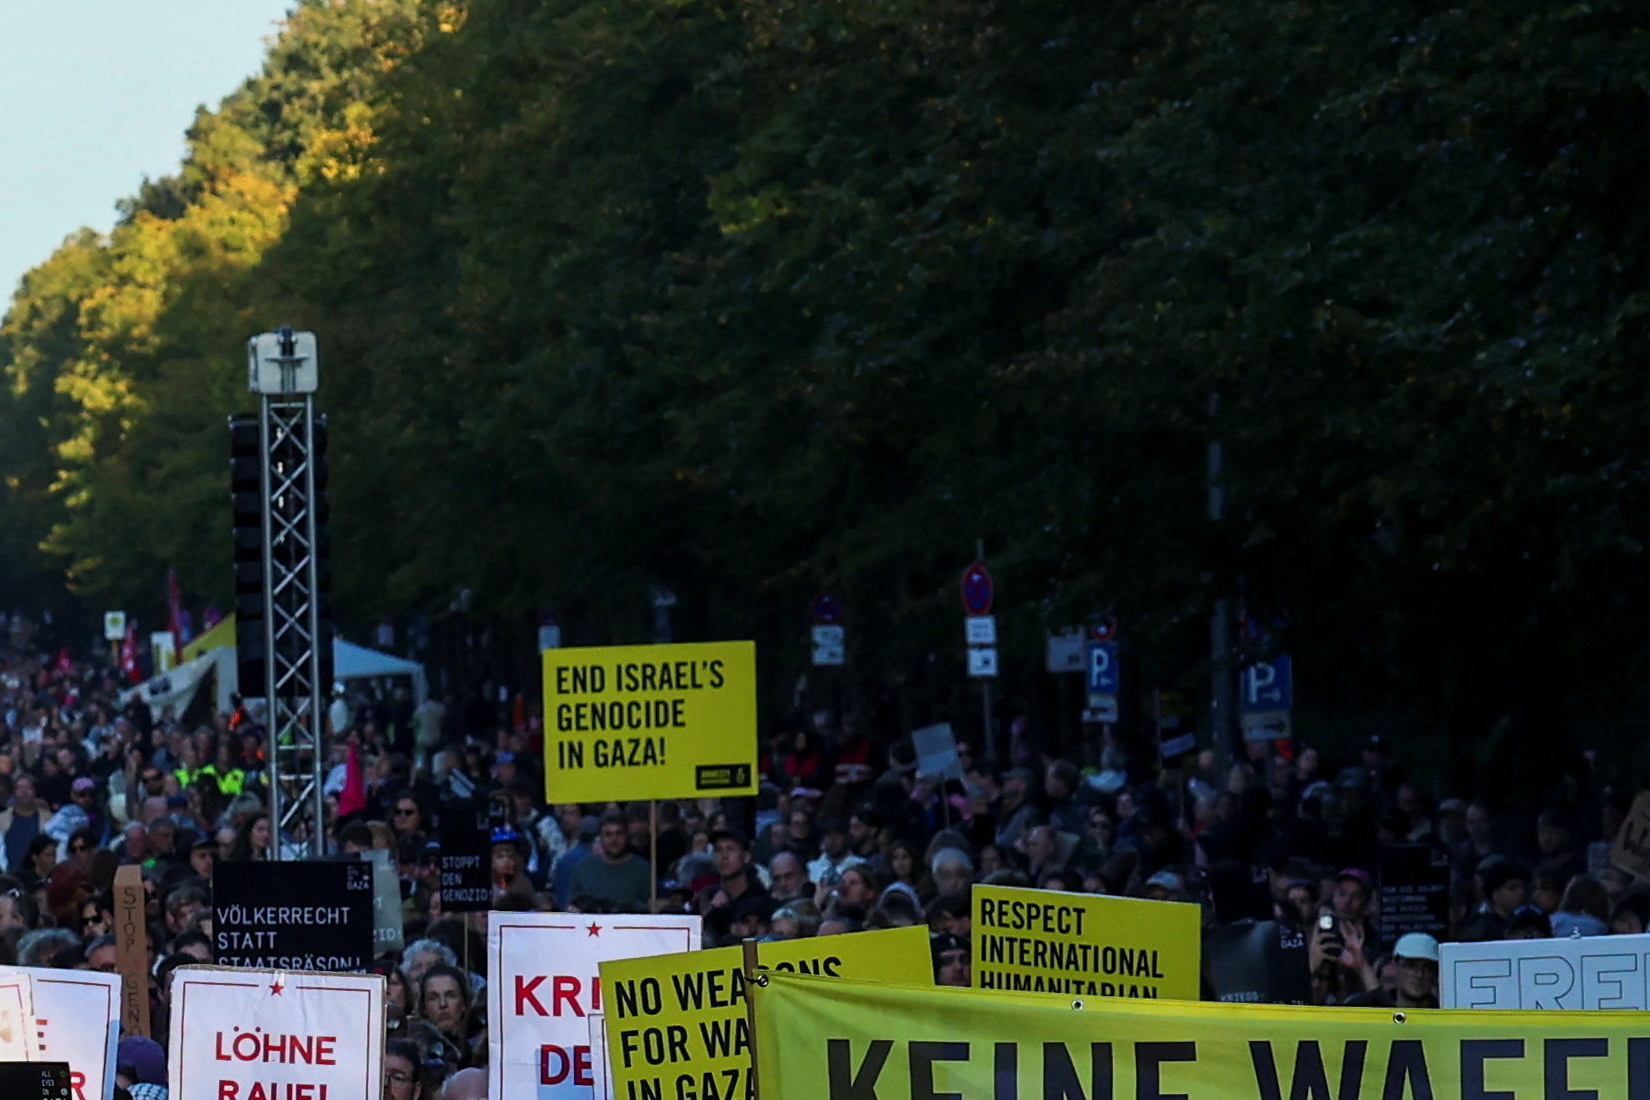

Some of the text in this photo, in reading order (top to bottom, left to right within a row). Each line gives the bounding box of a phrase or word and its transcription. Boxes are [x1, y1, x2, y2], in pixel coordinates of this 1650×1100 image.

[556, 666, 605, 694] END
[1091, 649, 1109, 686] P
[1249, 662, 1275, 703] P
[557, 699, 686, 732] GENOCIDE
[558, 737, 666, 770] IN GAZA!
[217, 903, 350, 925] VÖLKERRECHT
[980, 898, 1086, 936] RESPECT
[218, 932, 276, 950] STATT
[980, 934, 1164, 979] INTERNATIONAL
[514, 976, 600, 1018] KRI
[614, 977, 662, 1019] NO
[1453, 952, 1650, 1010] FRE
[215, 1026, 337, 1065] LÖHNE
[621, 1018, 751, 1067] FOR WA
[540, 1045, 594, 1085] DE
